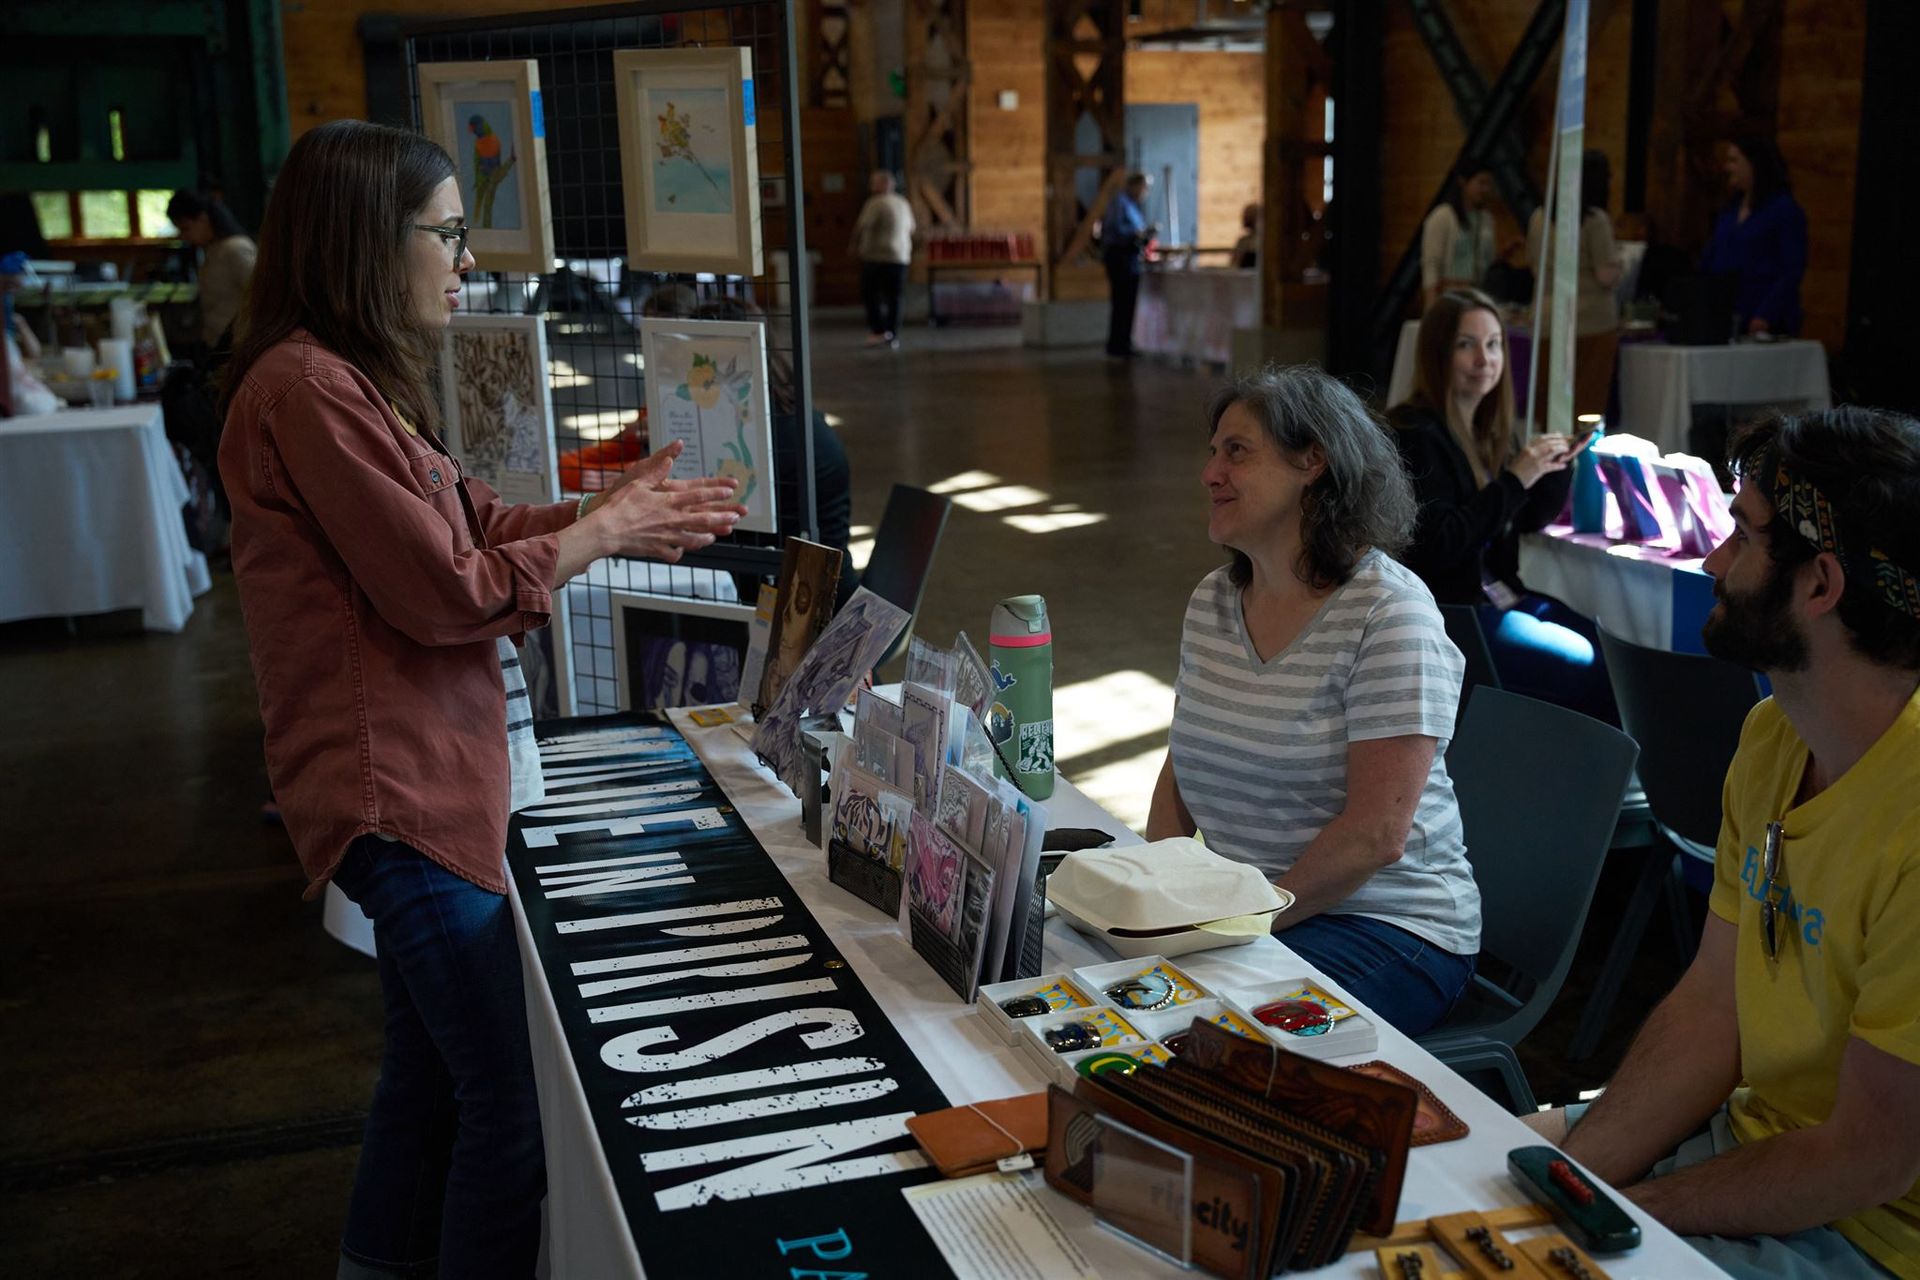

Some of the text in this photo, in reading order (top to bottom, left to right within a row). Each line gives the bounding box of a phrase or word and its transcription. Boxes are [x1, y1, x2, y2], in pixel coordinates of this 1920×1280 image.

[518, 727, 930, 1213] MADE IN PRISON
[1195, 1195, 1249, 1251] city
